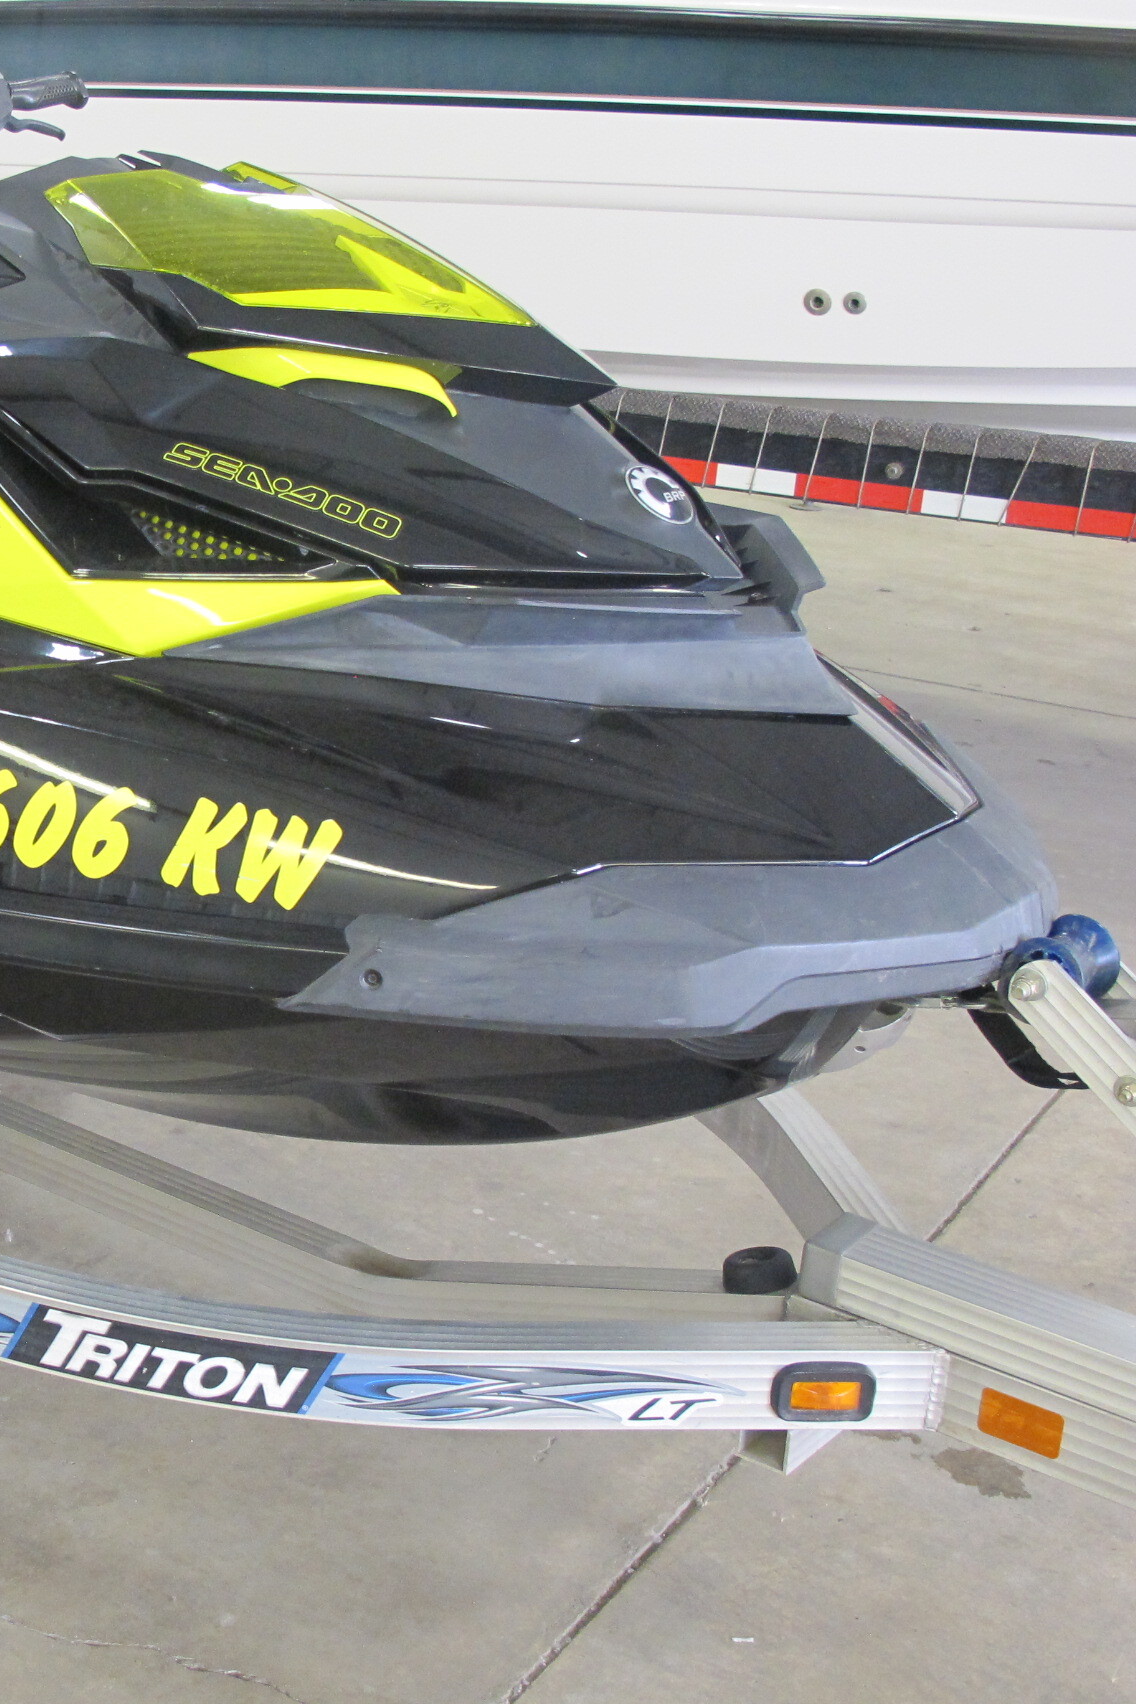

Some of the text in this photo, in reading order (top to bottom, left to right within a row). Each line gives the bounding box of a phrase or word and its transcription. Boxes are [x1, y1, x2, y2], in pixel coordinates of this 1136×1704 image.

[663, 490, 686, 503] BRP
[161, 796, 342, 910] KW
[38, 1308, 309, 1408] TRITON
[627, 1397, 717, 1421] LT
